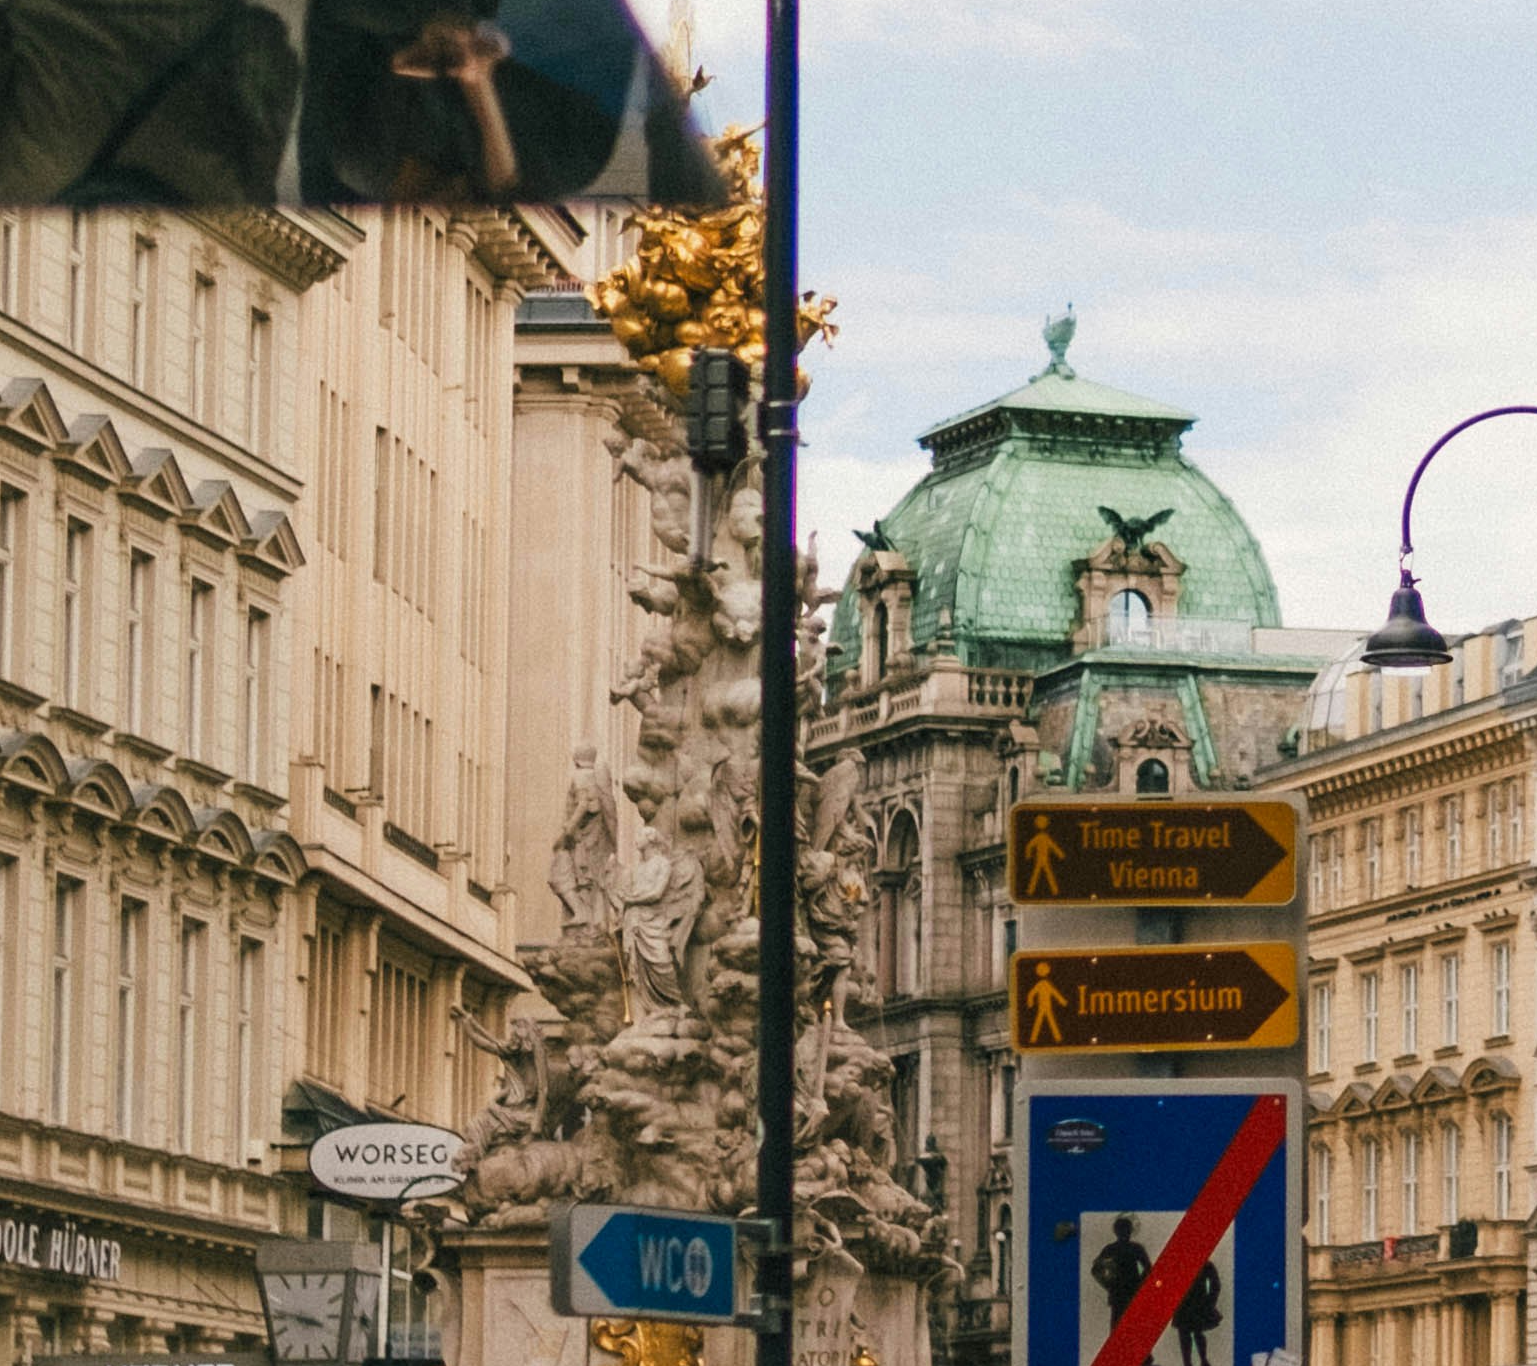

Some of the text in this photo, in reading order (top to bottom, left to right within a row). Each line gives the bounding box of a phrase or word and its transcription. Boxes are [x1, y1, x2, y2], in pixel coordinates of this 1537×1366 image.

[1079, 820, 1231, 849] Time Travel
[1109, 860, 1199, 888] Vienna
[1077, 979, 1242, 1015] Immersium
[335, 1144, 448, 1165] WORSEG
[49, 1221, 121, 1281] HÜBNER
